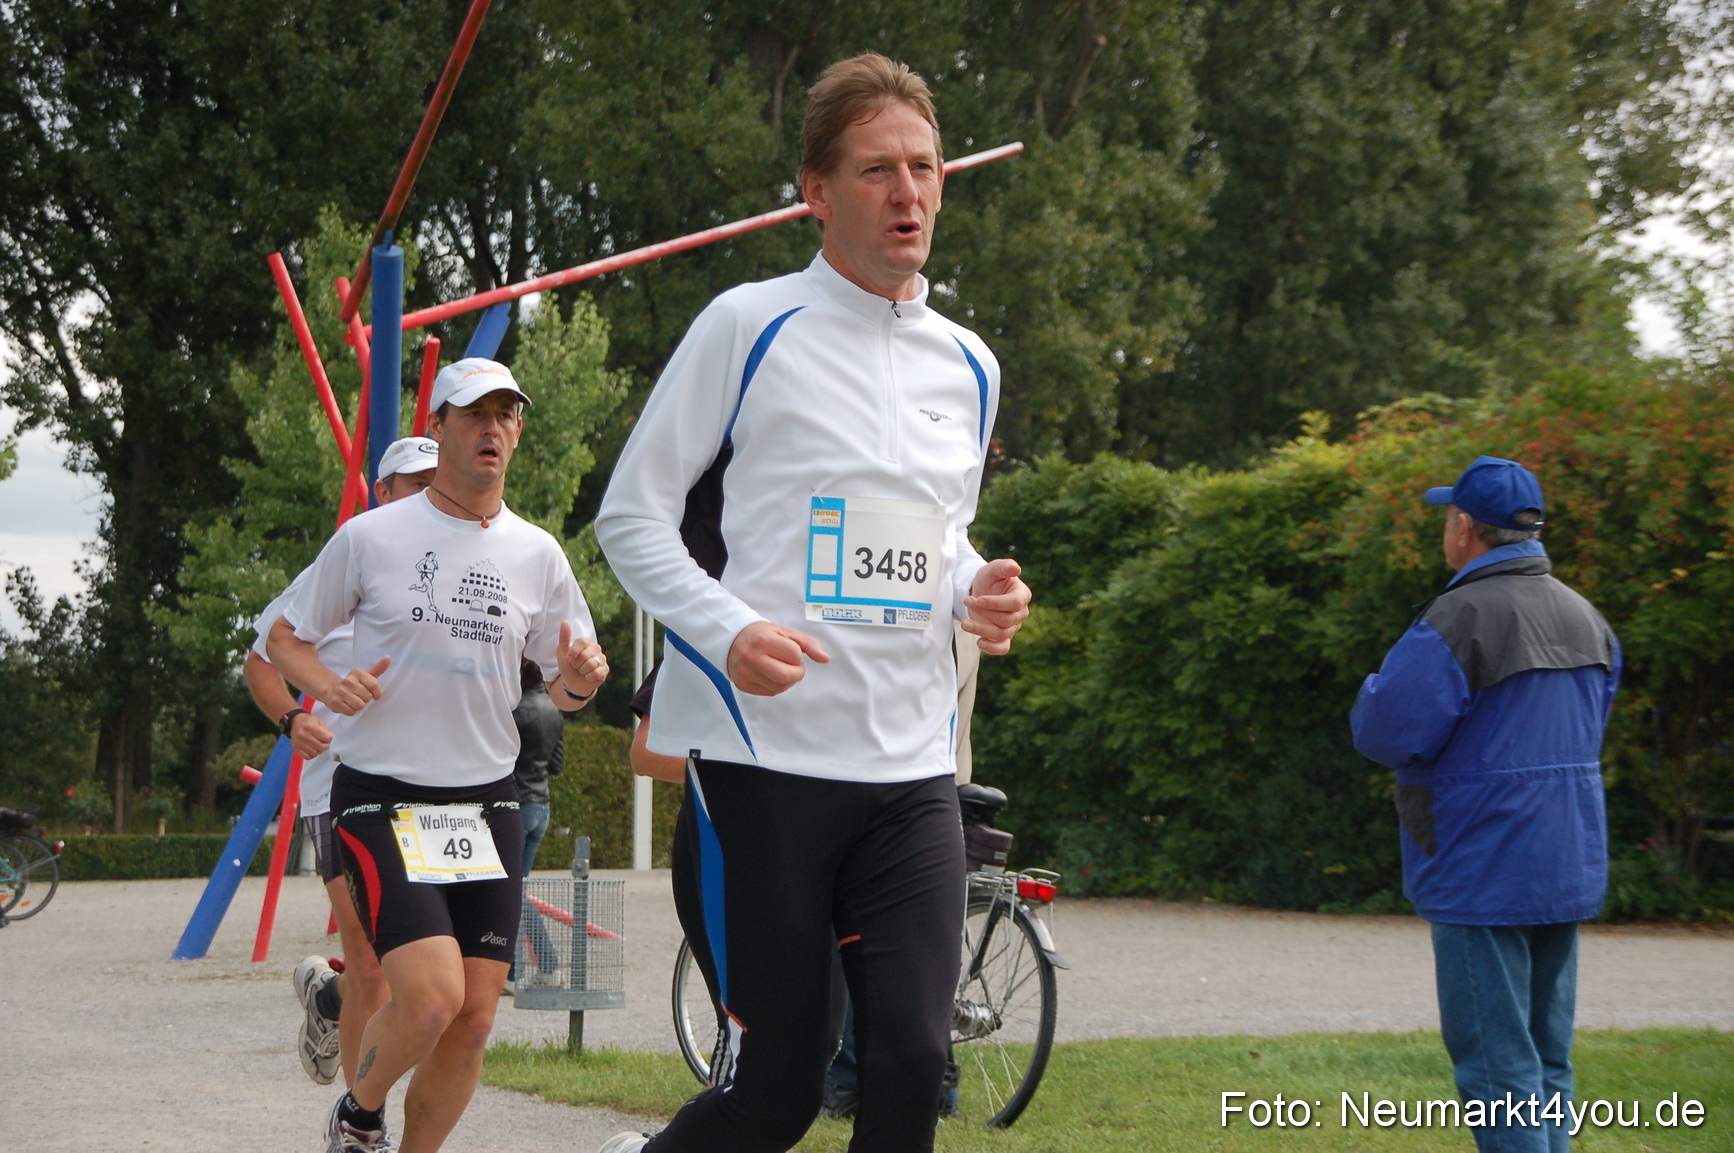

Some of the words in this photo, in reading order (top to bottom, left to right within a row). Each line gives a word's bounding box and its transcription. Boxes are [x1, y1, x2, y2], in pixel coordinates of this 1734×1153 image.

[853, 547, 927, 584] 3458
[458, 586, 508, 604] 21.09.2008
[411, 606, 431, 622] 9.
[434, 613, 504, 634] Neumarkter
[821, 607, 863, 619] BOCK
[897, 608, 931, 622] PFLEIDERER
[450, 626, 503, 645] Stadtlauf
[419, 814, 478, 832] Wolfgang
[443, 838, 473, 860] 49
